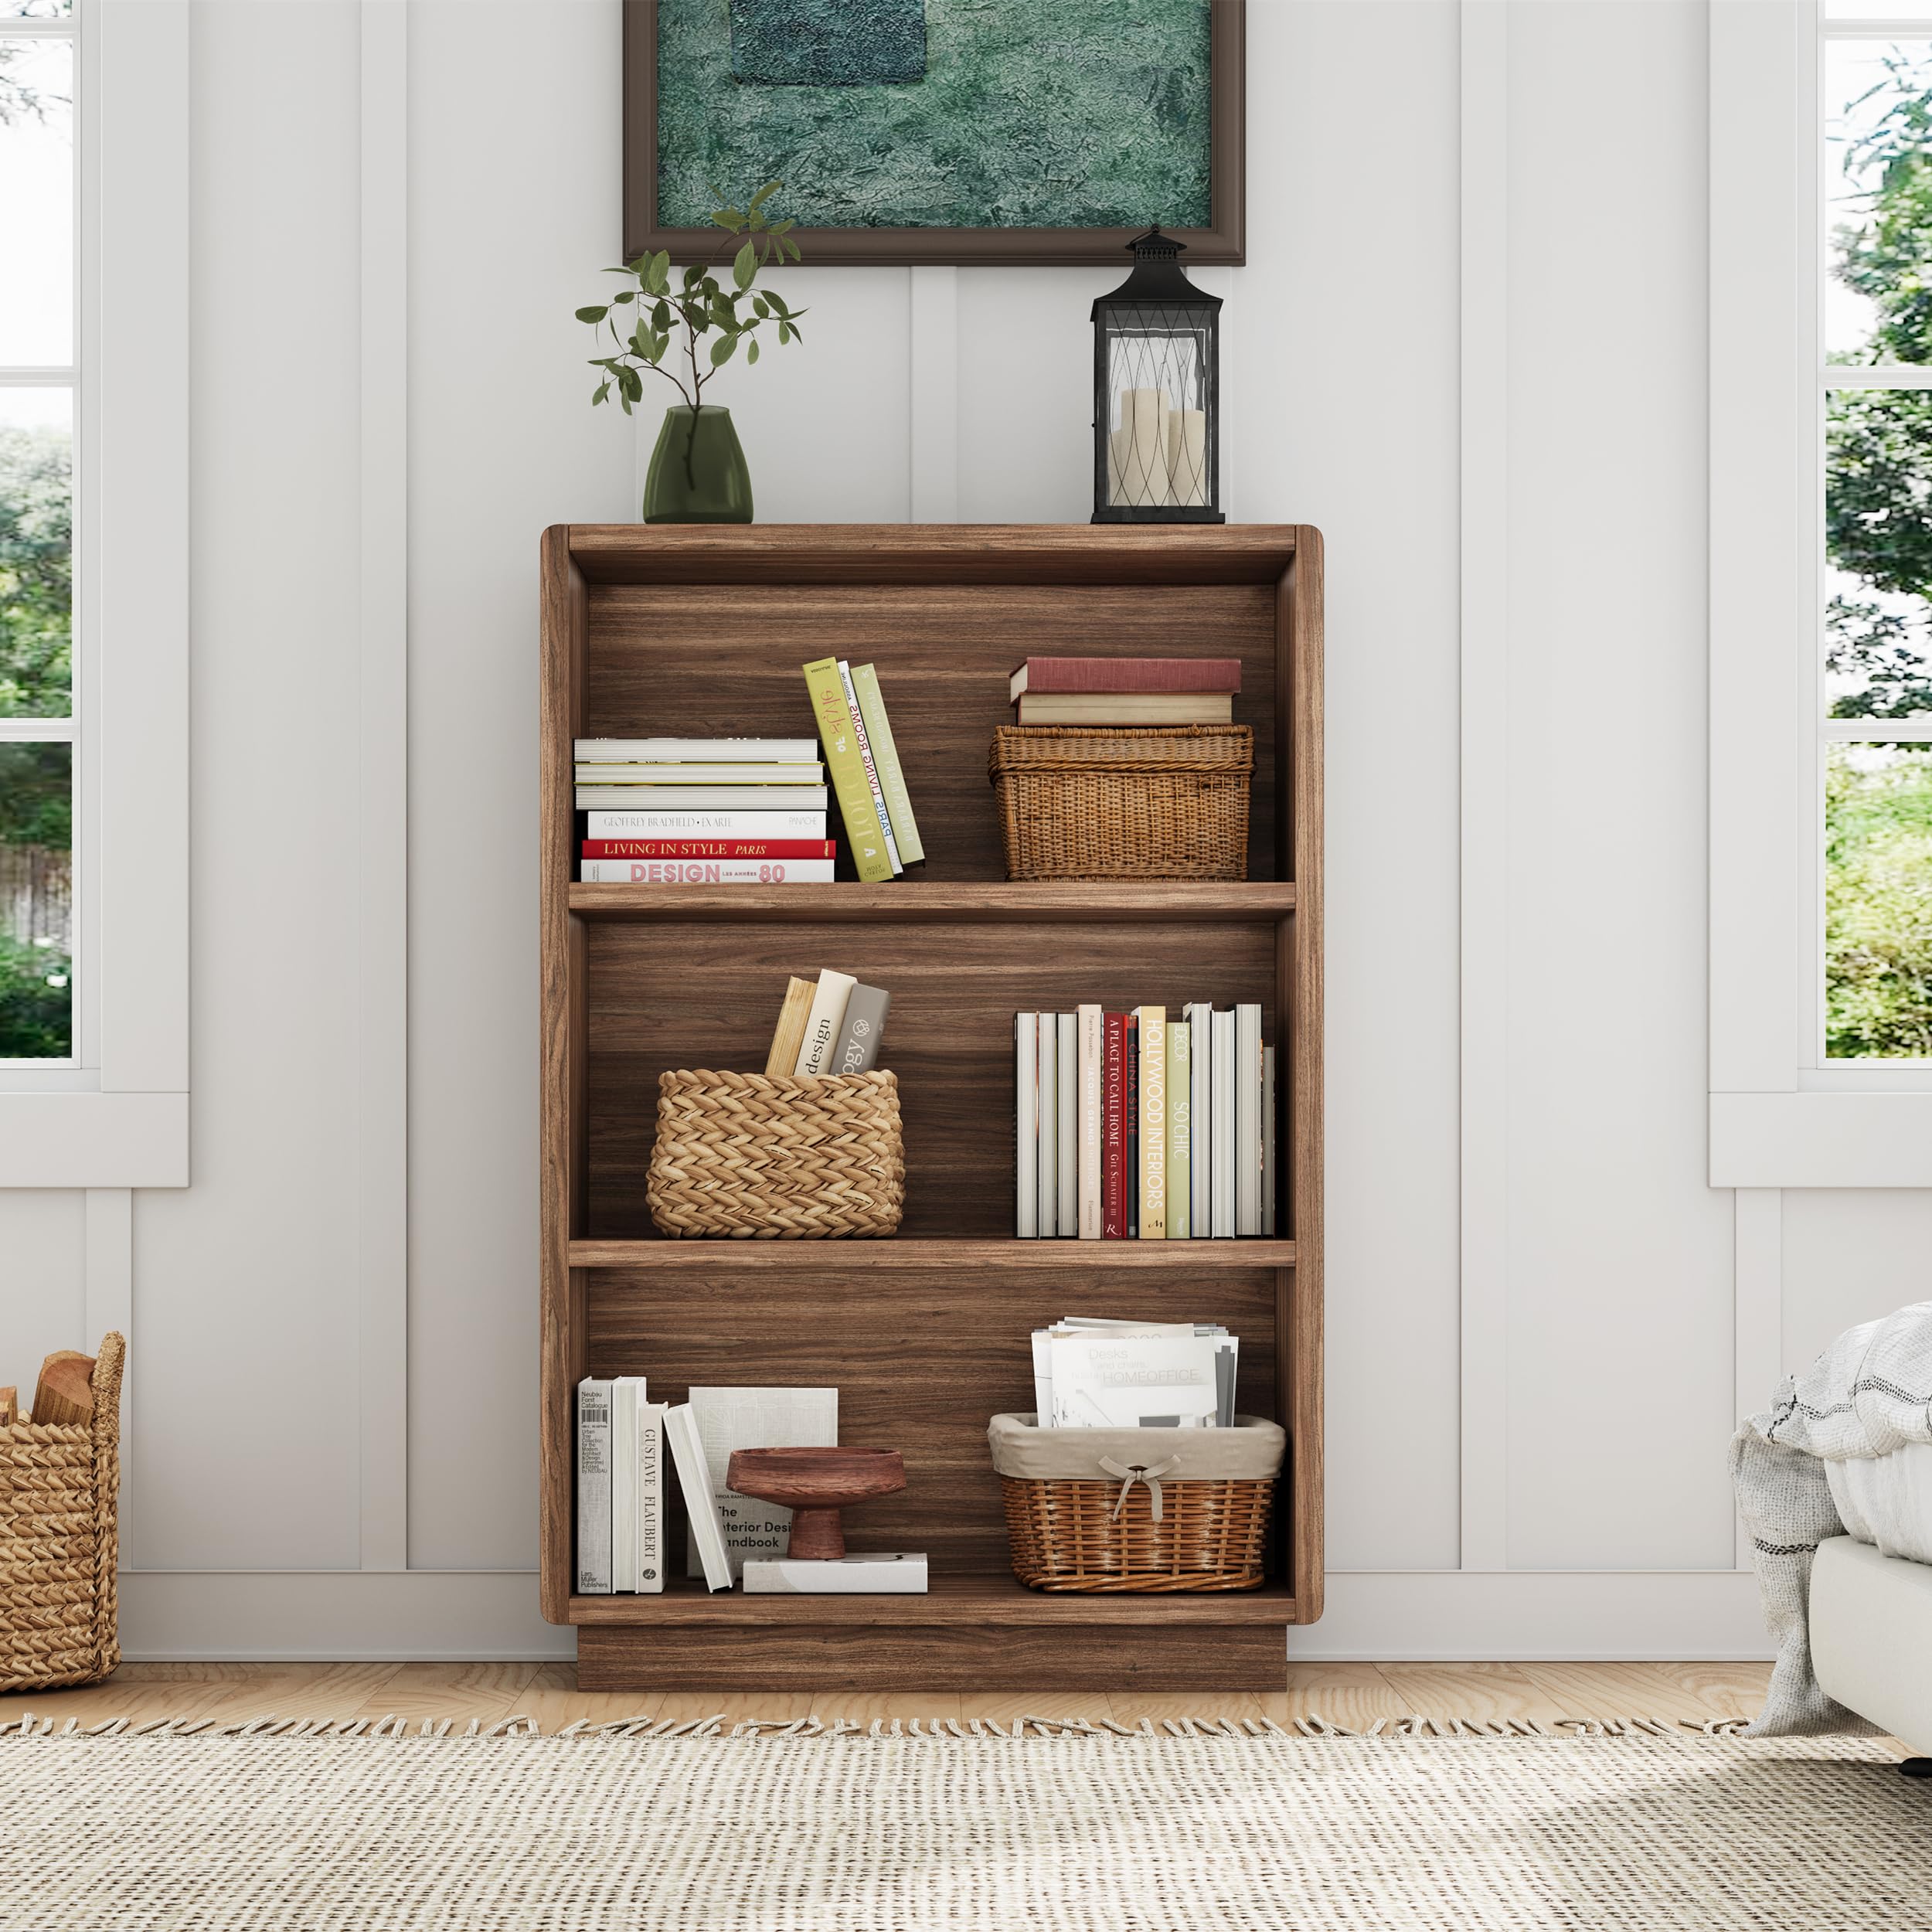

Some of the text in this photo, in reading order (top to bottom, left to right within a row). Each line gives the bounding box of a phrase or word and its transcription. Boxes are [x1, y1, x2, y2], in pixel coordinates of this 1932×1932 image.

[604, 817, 645, 827] GEOFFREY
[648, 817, 695, 827] BRADFIELD
[604, 843, 767, 855] LIVING IN STYLE PARIS
[631, 864, 720, 882] DESIGN
[759, 864, 785, 882] 80
[805, 1019, 831, 1074] design
[835, 1039, 865, 1076] ogy
[1110, 1031, 1119, 1063] PLACE
[1110, 1066, 1119, 1081] TO
[1110, 1084, 1119, 1111] CALL
[1146, 1020, 1163, 1209] HOLLYWOOD INTERIORS
[1110, 1114, 1119, 1147] HOME
[1174, 1101, 1189, 1159] SO CHIC
[1088, 1347, 1128, 1360] Desks
[1102, 1368, 1200, 1385] HOMEOFFICE
[645, 1429, 656, 1560] GUSTAVE FLAUBERT
[723, 1521, 791, 1532] terior Desi
